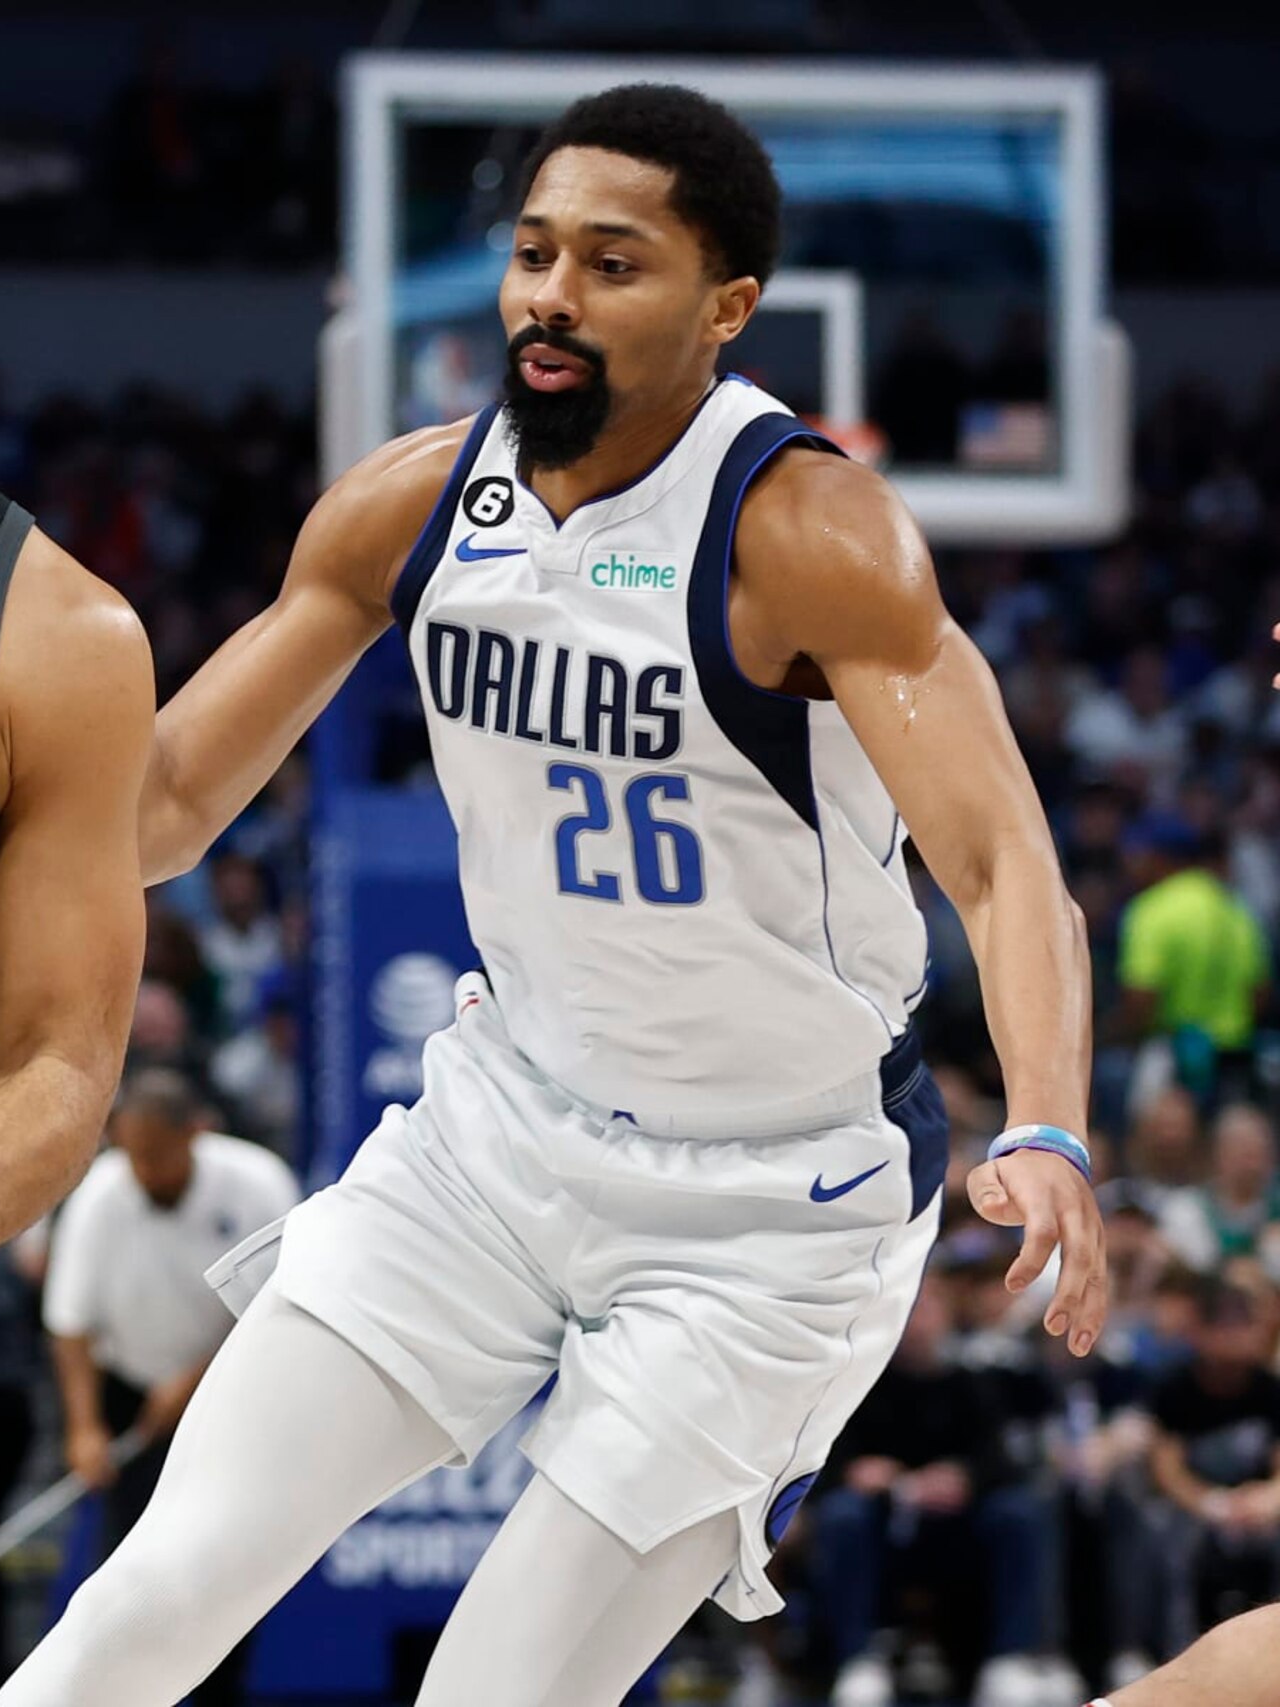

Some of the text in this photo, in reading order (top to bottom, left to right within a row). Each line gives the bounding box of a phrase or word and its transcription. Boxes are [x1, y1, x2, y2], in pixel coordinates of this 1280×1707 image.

[471, 482, 510, 522] 6
[590, 554, 677, 590] chime
[424, 619, 687, 761] DALLAS
[546, 759, 707, 907] 26
